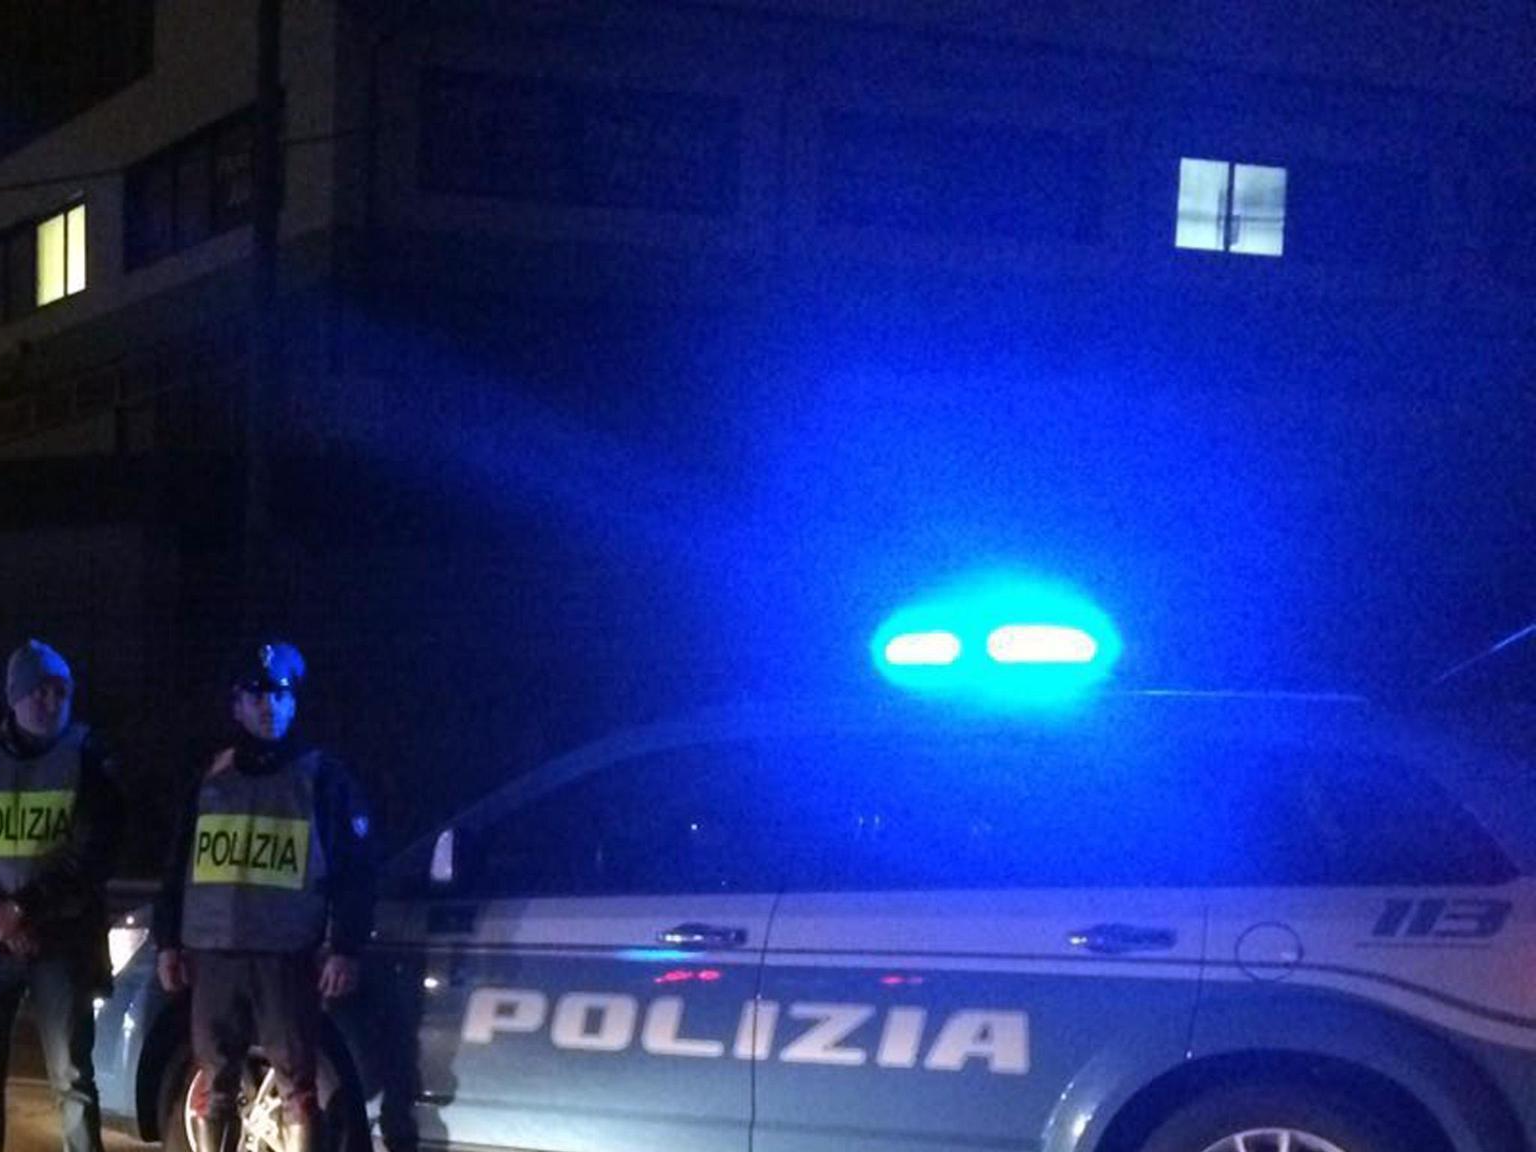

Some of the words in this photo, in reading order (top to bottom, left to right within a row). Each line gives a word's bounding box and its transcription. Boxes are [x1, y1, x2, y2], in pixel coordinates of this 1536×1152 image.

[197, 831, 298, 872] POLIZIA
[1372, 899, 1513, 937] 113
[463, 987, 1031, 1075] POLIZIA
